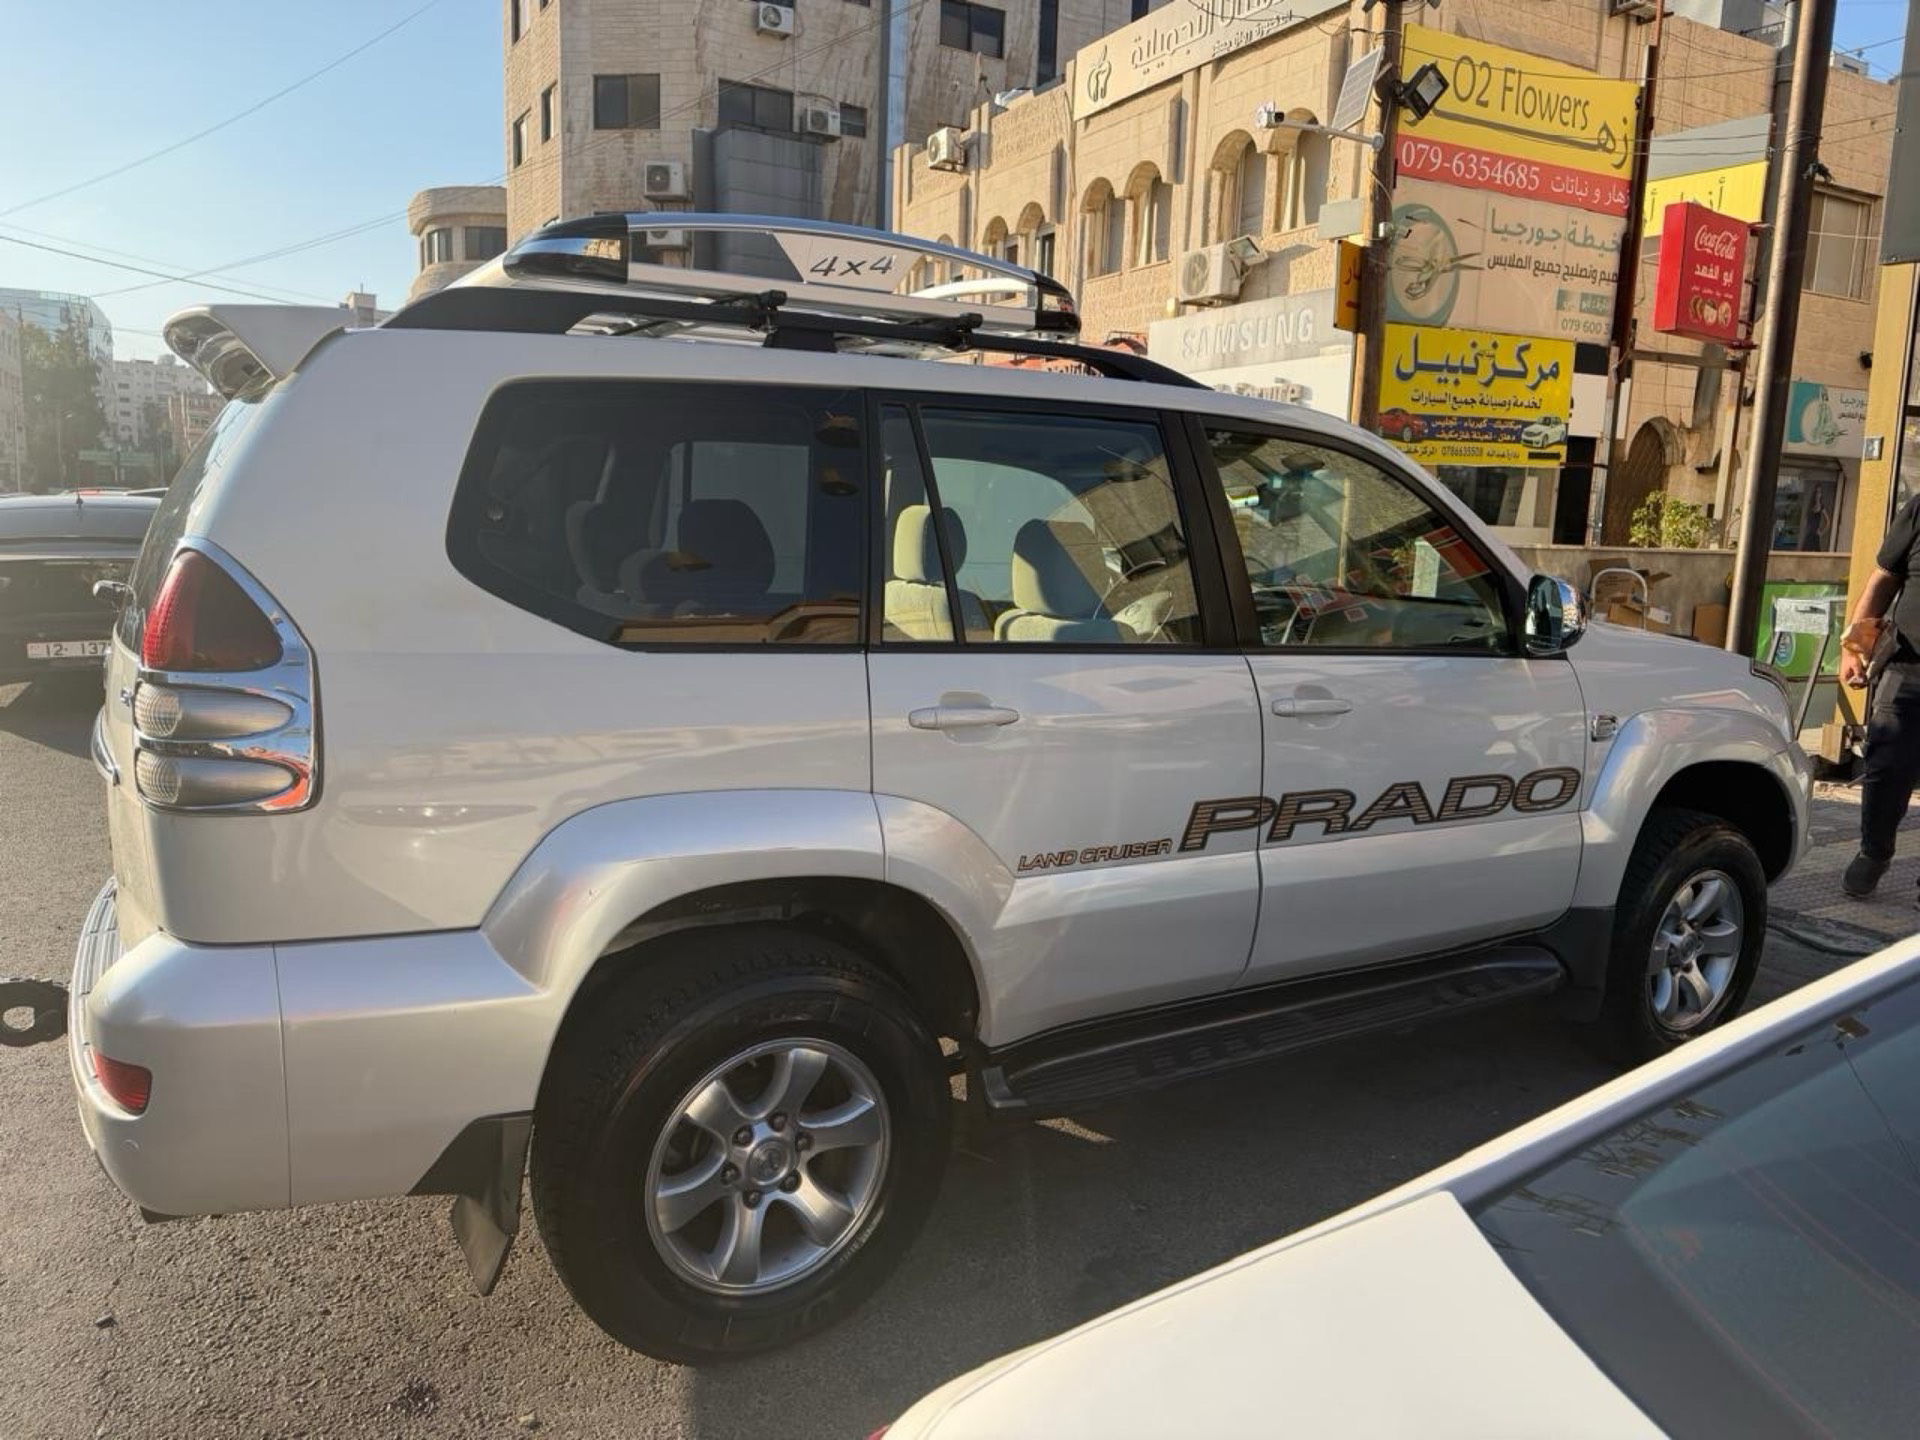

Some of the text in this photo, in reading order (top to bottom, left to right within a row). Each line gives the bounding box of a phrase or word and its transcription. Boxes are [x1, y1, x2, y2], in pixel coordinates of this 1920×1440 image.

[1453, 55, 1589, 131] O2 Flowers
[1402, 141, 1540, 191] 079-6354685
[1551, 176, 1588, 203] نباتات
[1491, 207, 1562, 250] جورجيا
[1488, 253, 1532, 271] الملابس
[1533, 259, 1560, 278] جميع
[1182, 308, 1314, 360] SAMSUNG
[1395, 332, 1560, 391] مركز نبيل
[1018, 767, 1581, 871] LAND CRUISER PRADO
